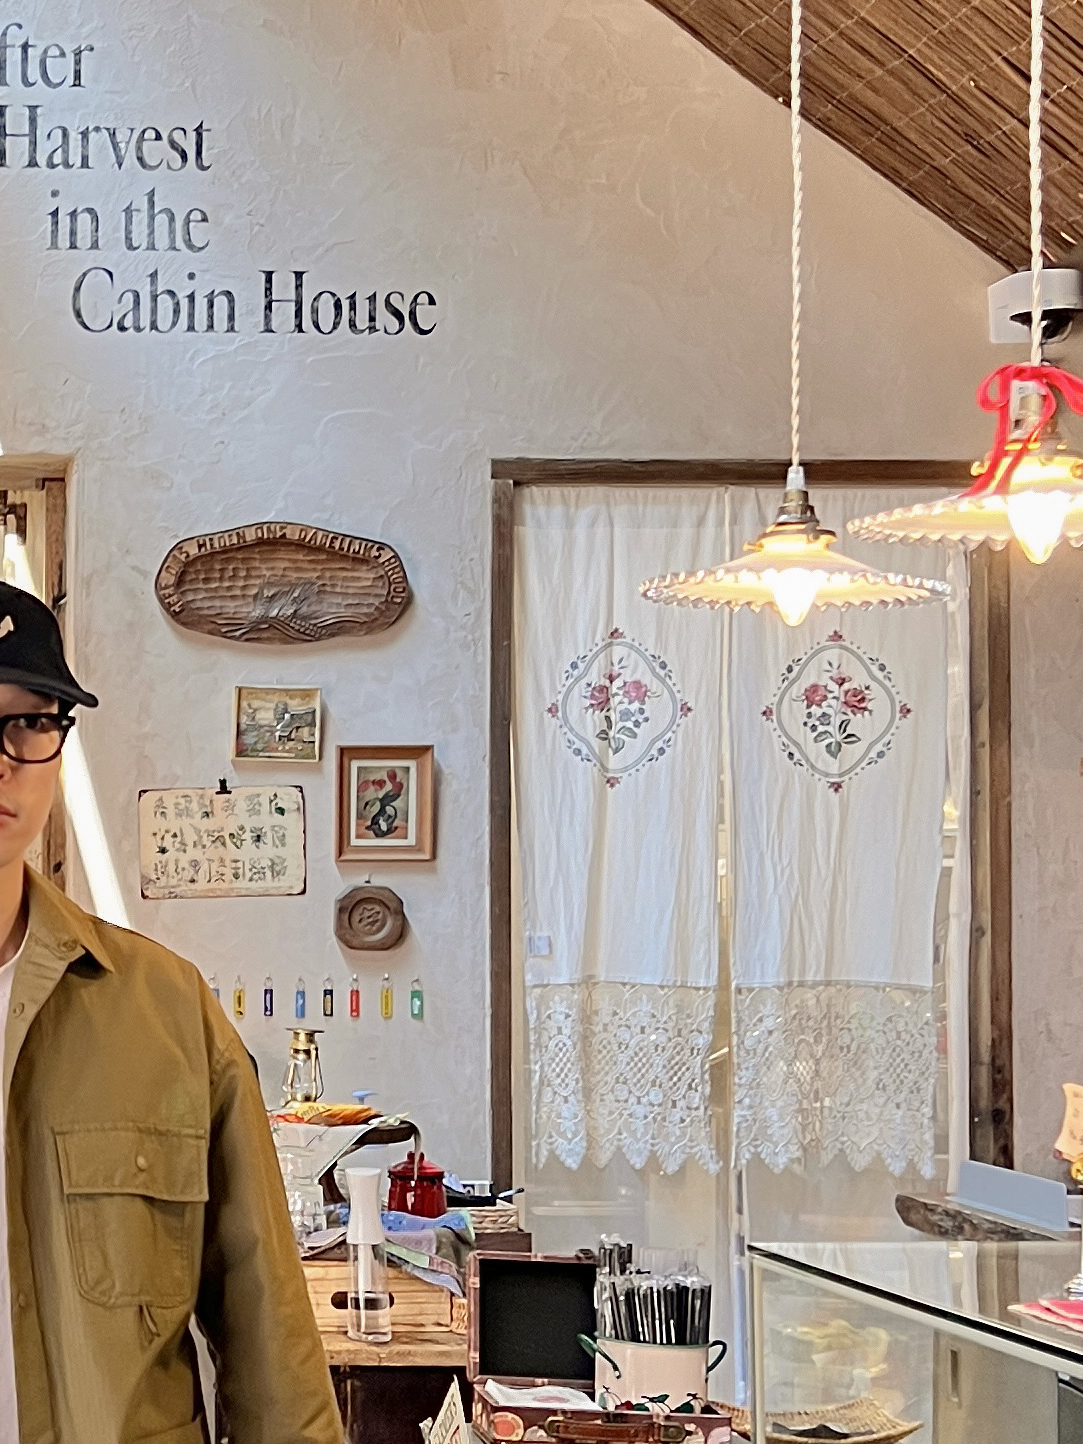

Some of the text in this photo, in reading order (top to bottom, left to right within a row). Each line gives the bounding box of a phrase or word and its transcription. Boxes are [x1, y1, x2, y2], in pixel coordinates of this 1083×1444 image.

[46, 187, 211, 254] in the
[71, 266, 438, 336] Cabin House
